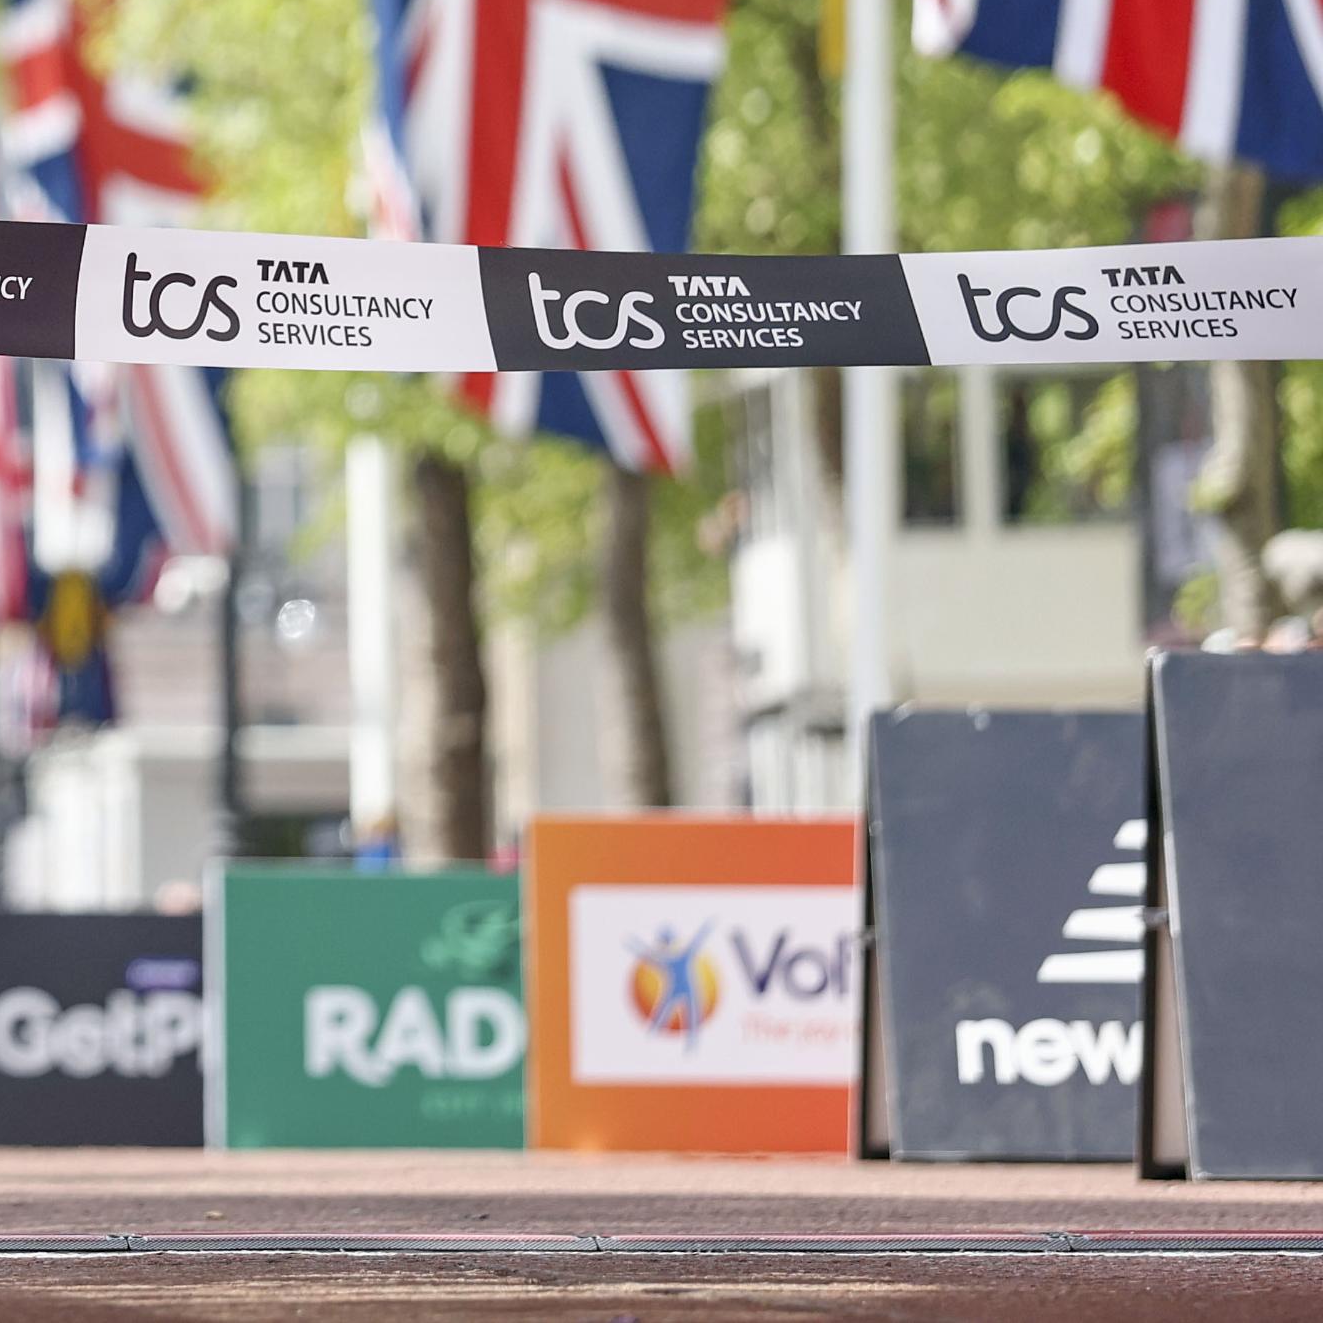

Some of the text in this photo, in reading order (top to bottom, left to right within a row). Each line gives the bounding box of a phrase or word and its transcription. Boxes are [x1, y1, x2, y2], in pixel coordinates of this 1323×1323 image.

[256, 259, 330, 285] TATA
[1101, 265, 1186, 288] TATA
[122, 251, 241, 342] tcs
[667, 275, 751, 297] TATA
[255, 290, 434, 320] CONSULTANCY
[528, 272, 666, 350] tcs
[675, 300, 862, 323] CONSULTANCY
[956, 273, 1100, 343] tcs
[1110, 288, 1298, 315] CONSULTANCY
[258, 321, 373, 347] SERVICES
[682, 328, 804, 349] SERVICES
[1118, 318, 1239, 341] SERVICES
[955, 1017, 1145, 1086] new
